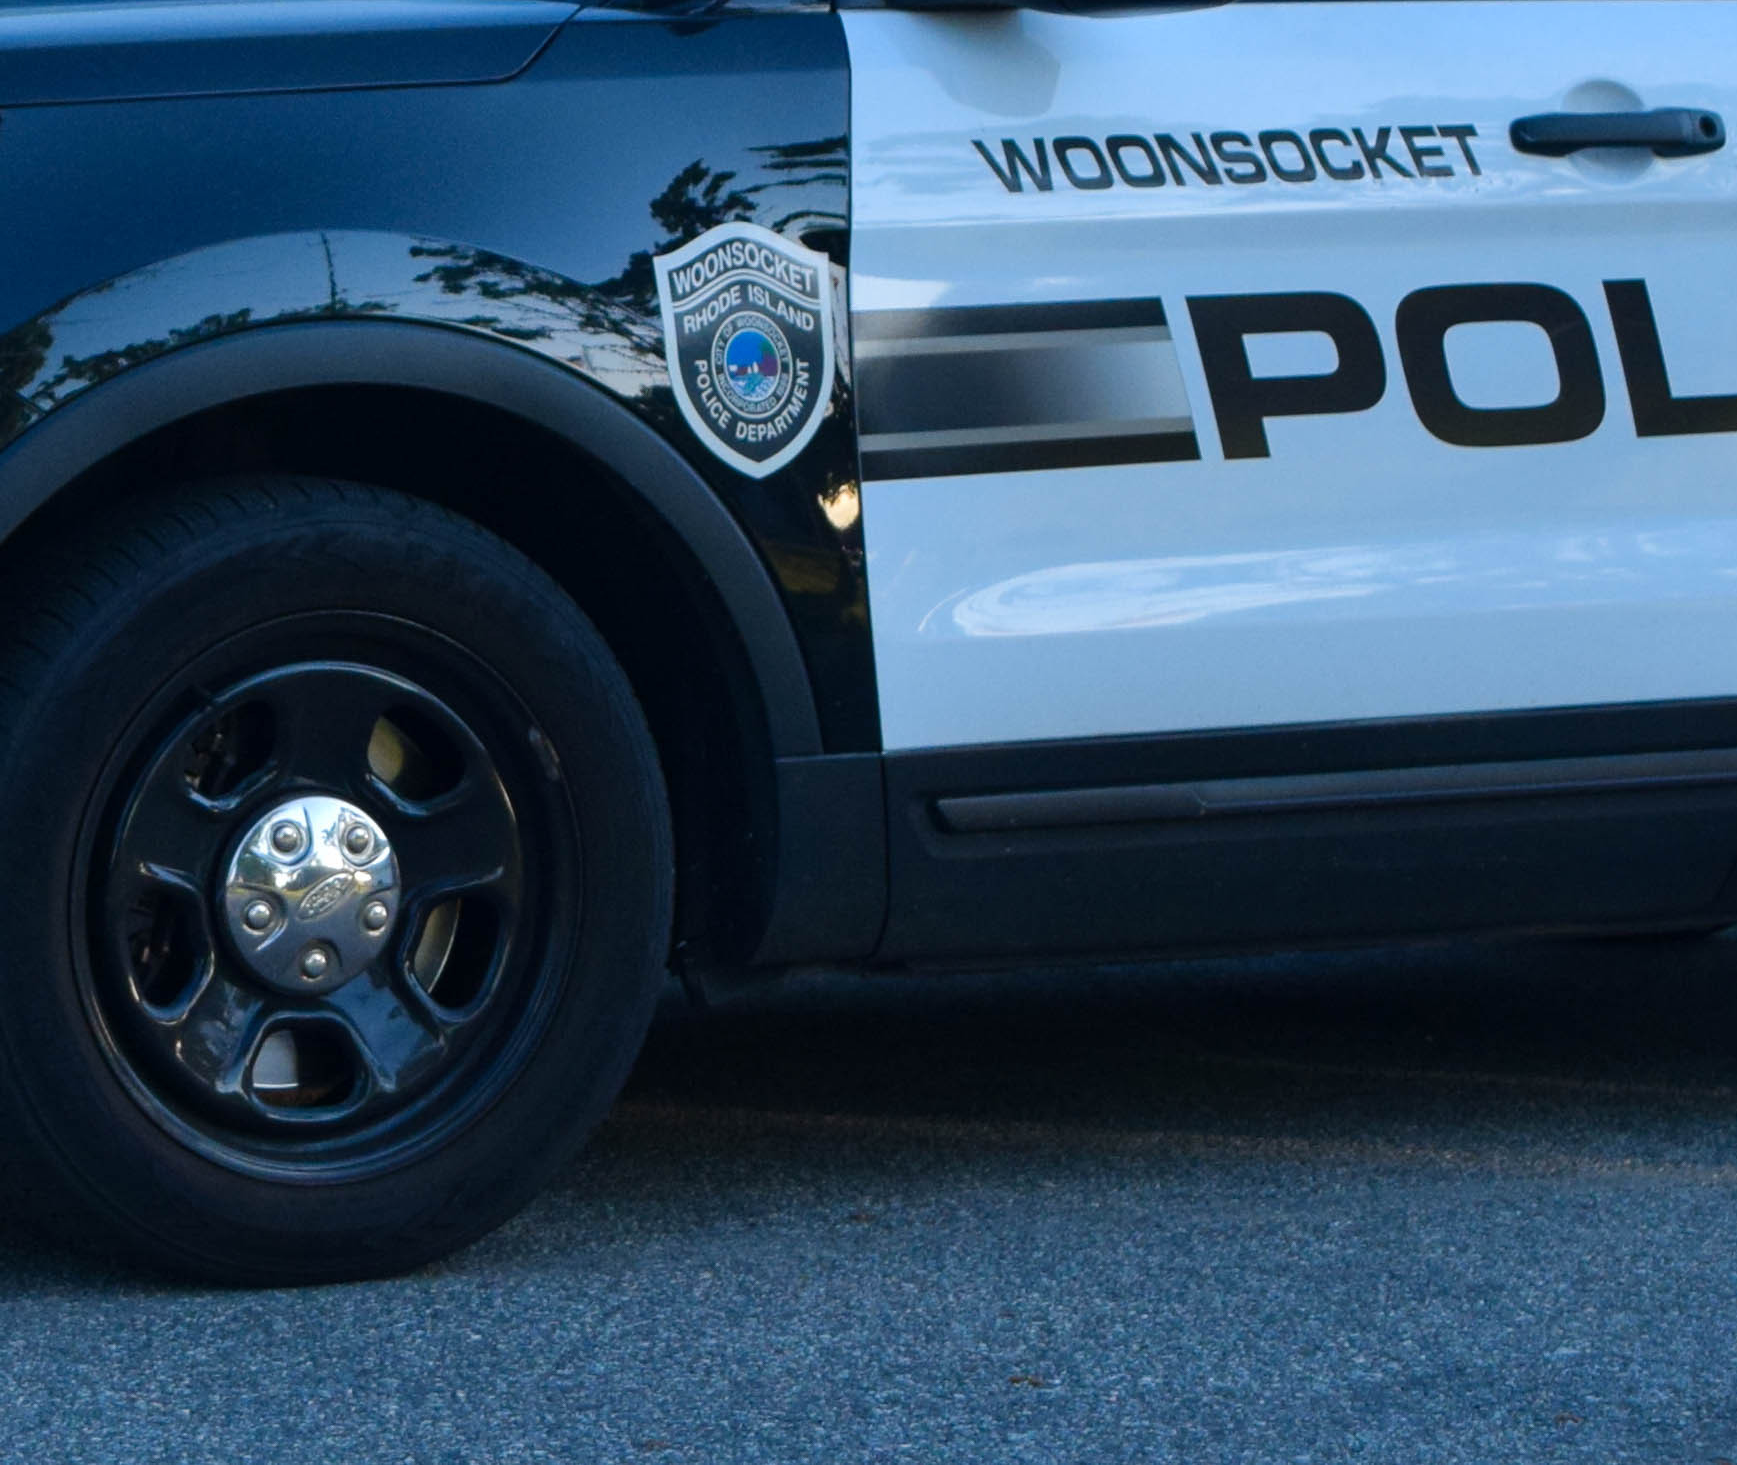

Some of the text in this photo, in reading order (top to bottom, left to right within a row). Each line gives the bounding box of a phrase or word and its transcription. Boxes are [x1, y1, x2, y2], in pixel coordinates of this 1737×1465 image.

[971, 124, 1482, 192] WOONSOCKET
[672, 241, 813, 295] WOONSOCKET
[684, 284, 814, 334] RHODE ISLAND
[694, 359, 810, 442] POLICE DEPARTMENT
